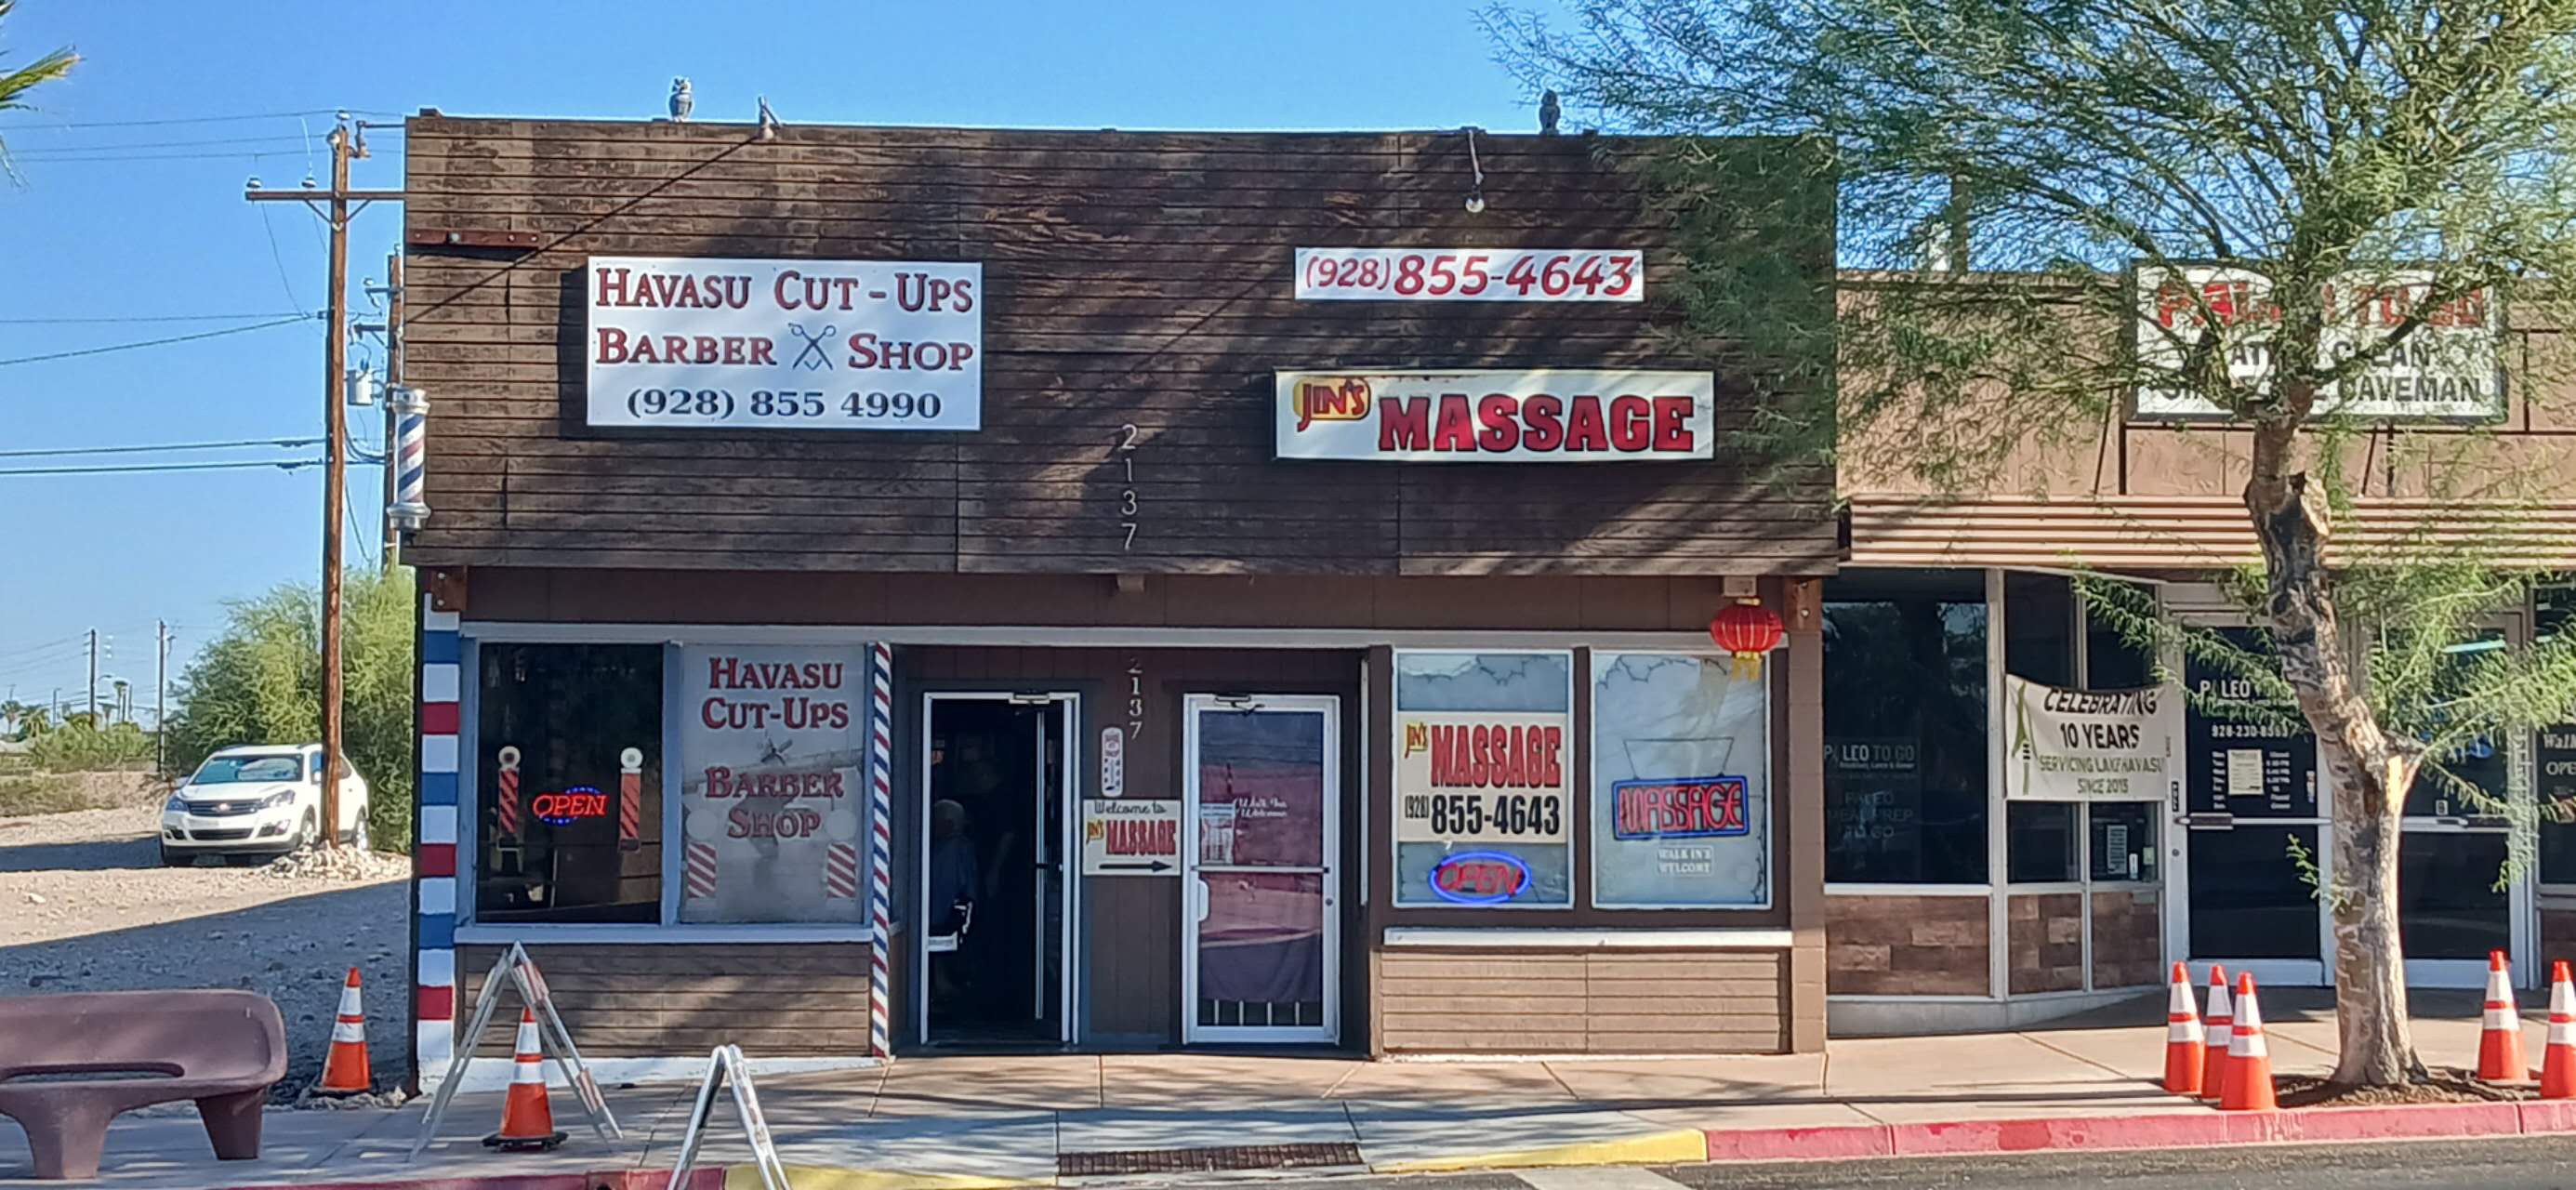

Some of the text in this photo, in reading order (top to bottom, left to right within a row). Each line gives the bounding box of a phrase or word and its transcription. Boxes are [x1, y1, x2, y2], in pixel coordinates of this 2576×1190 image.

[595, 267, 750, 310] HAVASU
[1305, 254, 1635, 297] (928) 855-4643
[596, 327, 973, 371] BARBER SHOP
[627, 389, 942, 419] (928) 855 4990
[1378, 393, 1695, 453] MASSAGE
[1120, 423, 1138, 551] 2137
[708, 656, 844, 690] HAVASU
[701, 696, 850, 730] CUT-UPS
[2043, 687, 2157, 715] CELEBRATING
[2060, 722, 2079, 748] 10
[2081, 723, 2140, 749] YEARS
[1430, 724, 1562, 789] MASSAGE
[705, 766, 844, 799] BARBER
[2077, 778, 2104, 794] SINCE
[532, 792, 610, 819] OPEN
[727, 806, 821, 838] SHOP
[1094, 800, 1151, 814] Welcome
[1405, 794, 1560, 835] (928) 855-4643
[1618, 783, 1745, 833] MASSAGE
[1105, 819, 1177, 856] MASSAGE
[1436, 862, 1523, 896] OPEN
